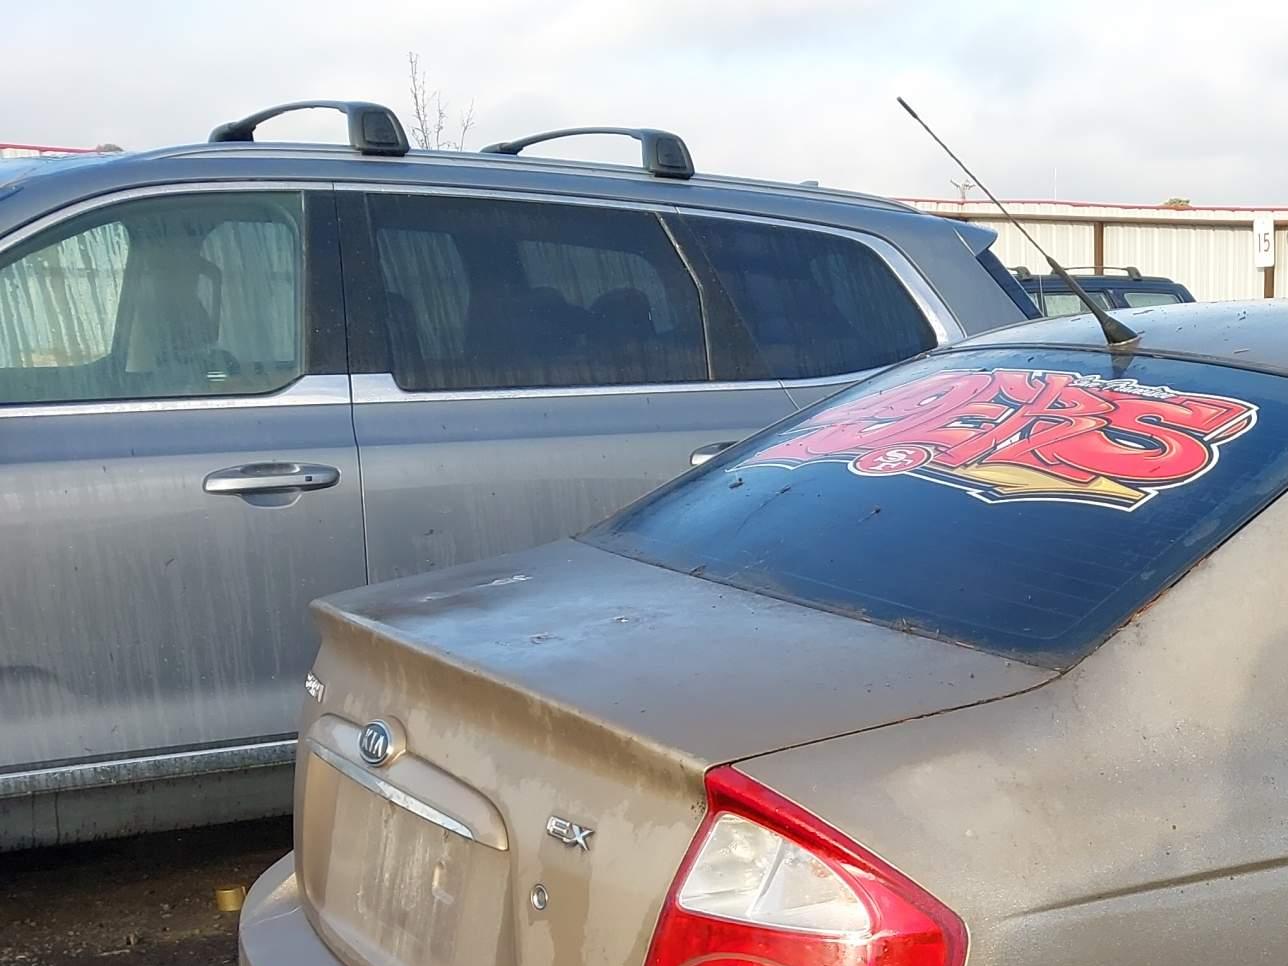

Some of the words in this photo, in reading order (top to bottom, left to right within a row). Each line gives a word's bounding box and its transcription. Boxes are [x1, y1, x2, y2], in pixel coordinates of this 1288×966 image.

[1257, 232, 1271, 252] 15
[361, 728, 385, 758] KIA
[546, 815, 594, 851] EX
